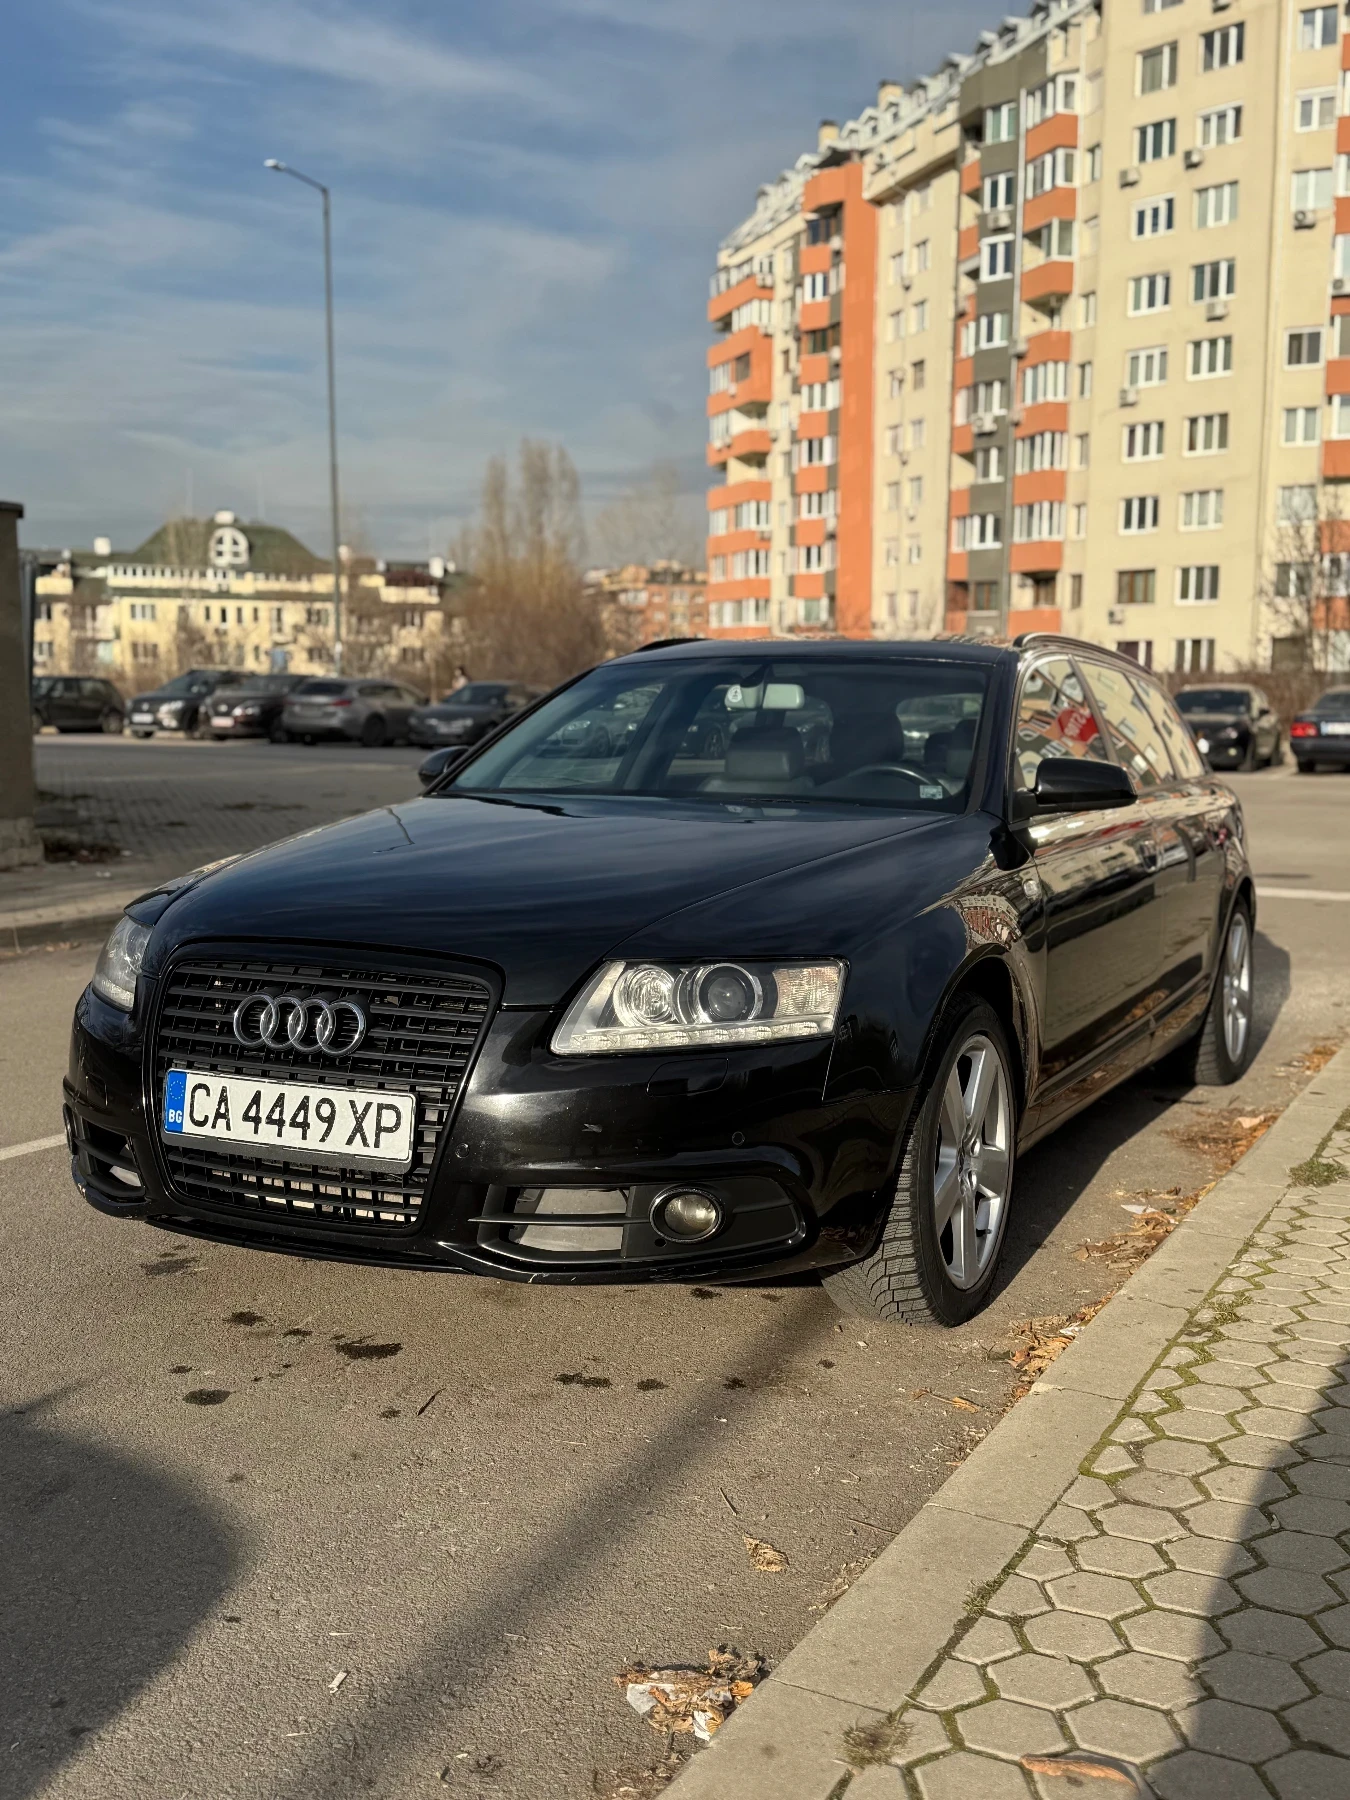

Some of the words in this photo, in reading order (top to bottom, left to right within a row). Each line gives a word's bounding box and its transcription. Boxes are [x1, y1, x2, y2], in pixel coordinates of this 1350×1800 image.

[168, 1109, 183, 1124] BG
[189, 1082, 232, 1132] CA
[241, 1089, 337, 1143] 4449
[345, 1099, 402, 1149] XP
